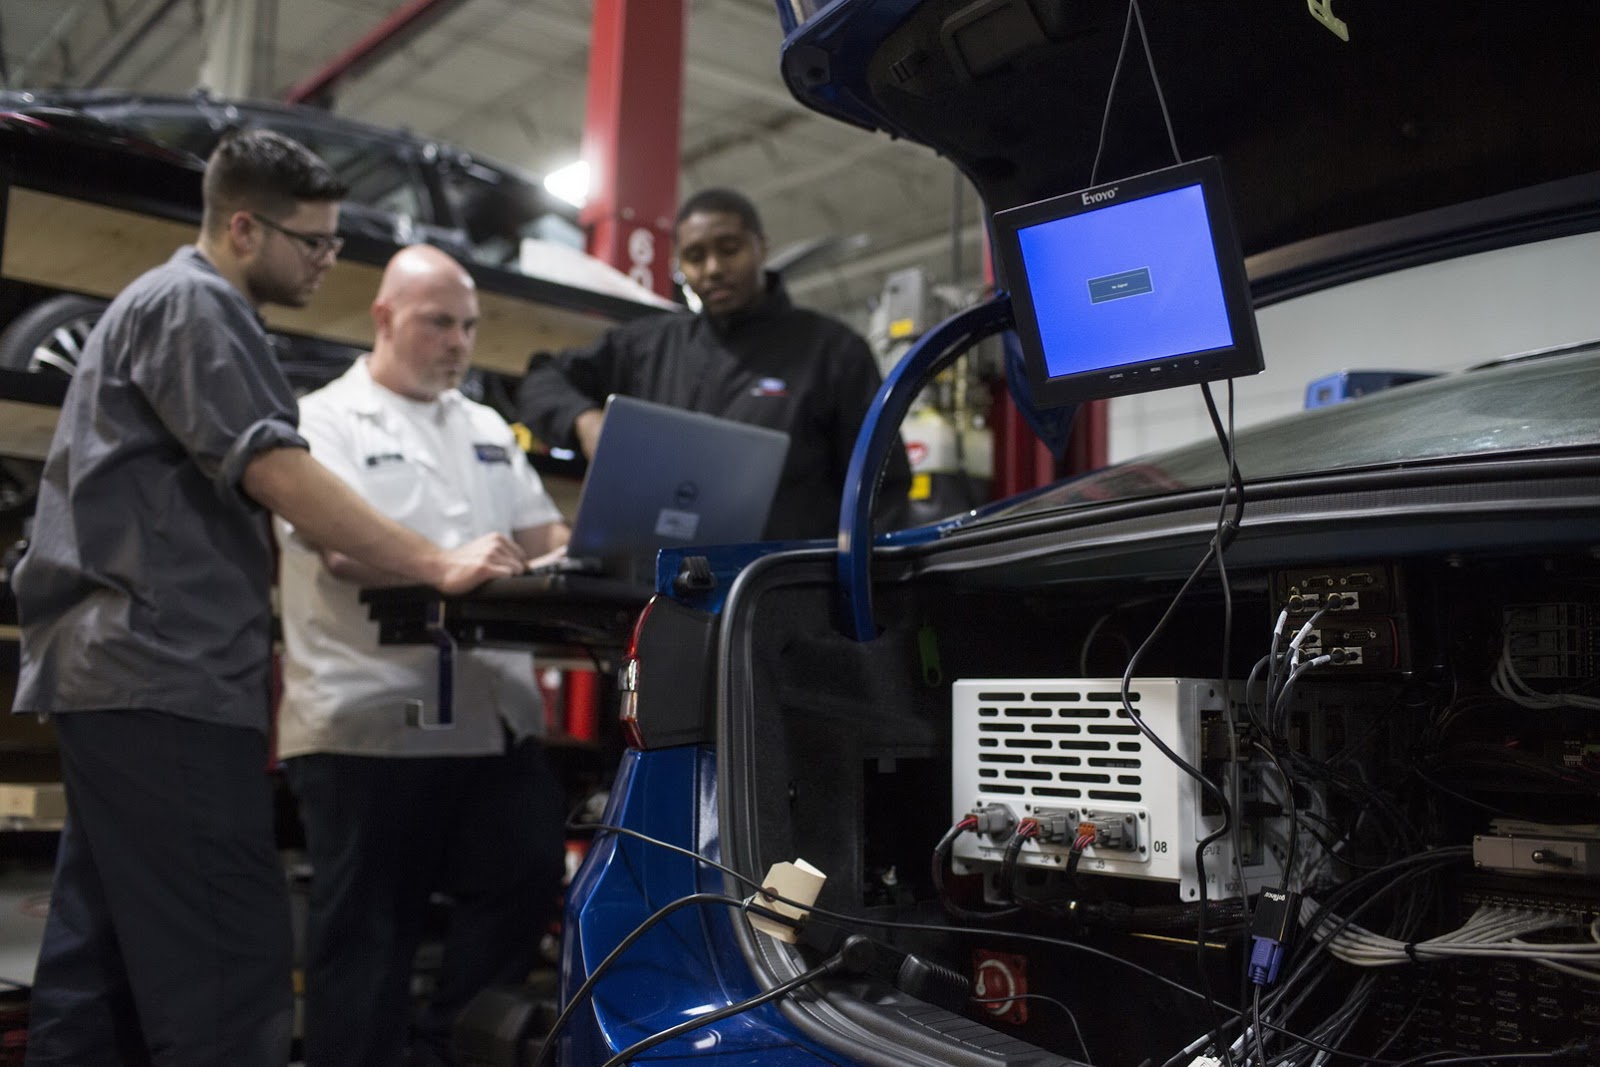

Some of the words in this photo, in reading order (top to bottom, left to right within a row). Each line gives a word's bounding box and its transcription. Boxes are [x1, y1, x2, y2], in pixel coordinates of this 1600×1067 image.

[1153, 840, 1168, 853] 08
[1040, 854, 1050, 864] J2
[1095, 859, 1106, 870] J3
